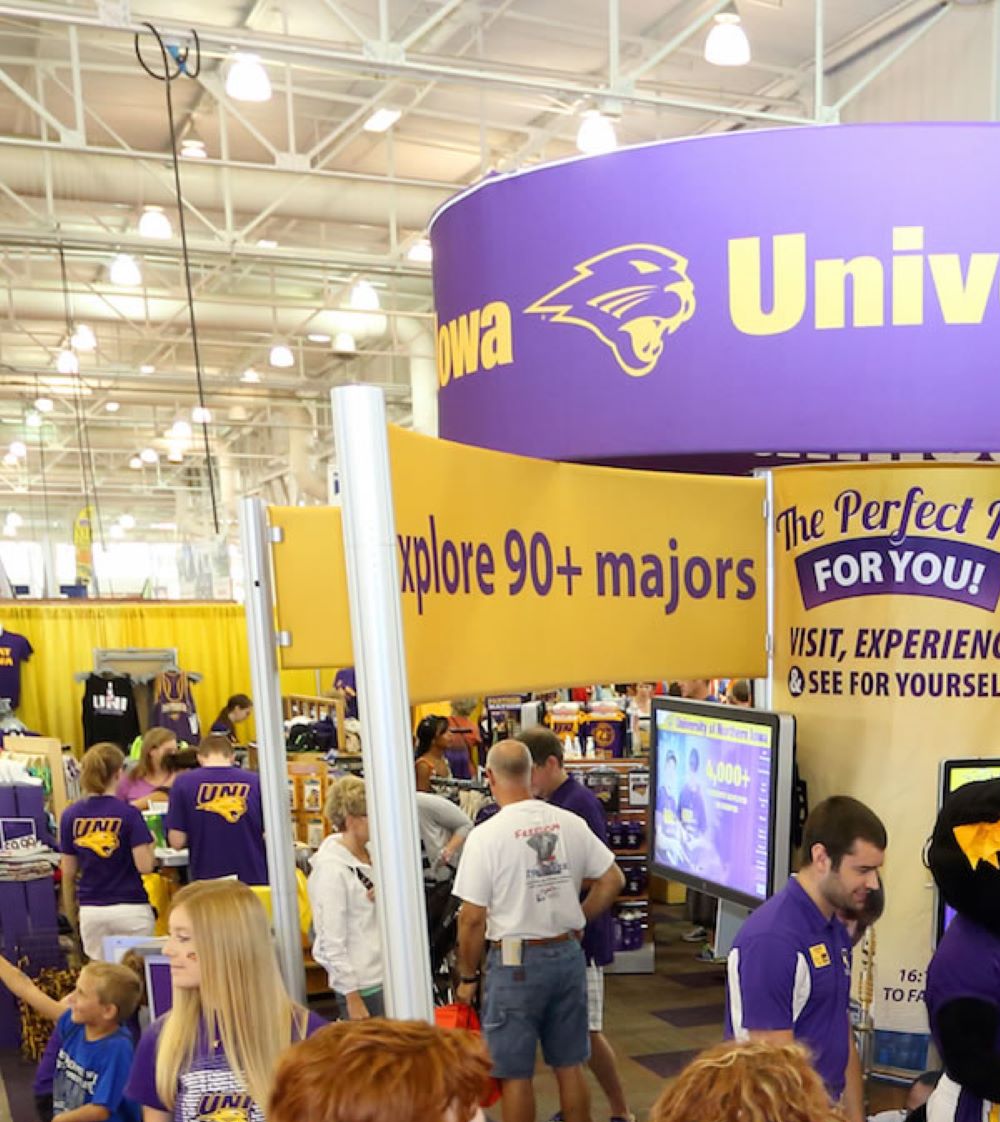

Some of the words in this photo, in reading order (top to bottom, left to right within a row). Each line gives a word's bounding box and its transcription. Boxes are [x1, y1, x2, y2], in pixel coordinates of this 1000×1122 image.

[436, 300, 514, 391] owa
[776, 504, 826, 551] The
[834, 486, 975, 547] Perfect
[397, 514, 495, 616] xplore
[504, 528, 582, 596] 90+
[595, 537, 757, 616] majors
[813, 552, 885, 593] FOR
[887, 550, 986, 595] YOU!
[790, 627, 848, 662] VISIT,
[788, 667, 804, 697] &
[809, 670, 843, 695] SEE
[850, 671, 889, 697] FOR
[198, 783, 250, 804] UNI
[74, 817, 122, 838] UNI
[900, 969, 928, 983] 16:
[882, 987, 904, 1003] TO
[198, 1093, 255, 1116] UNI
